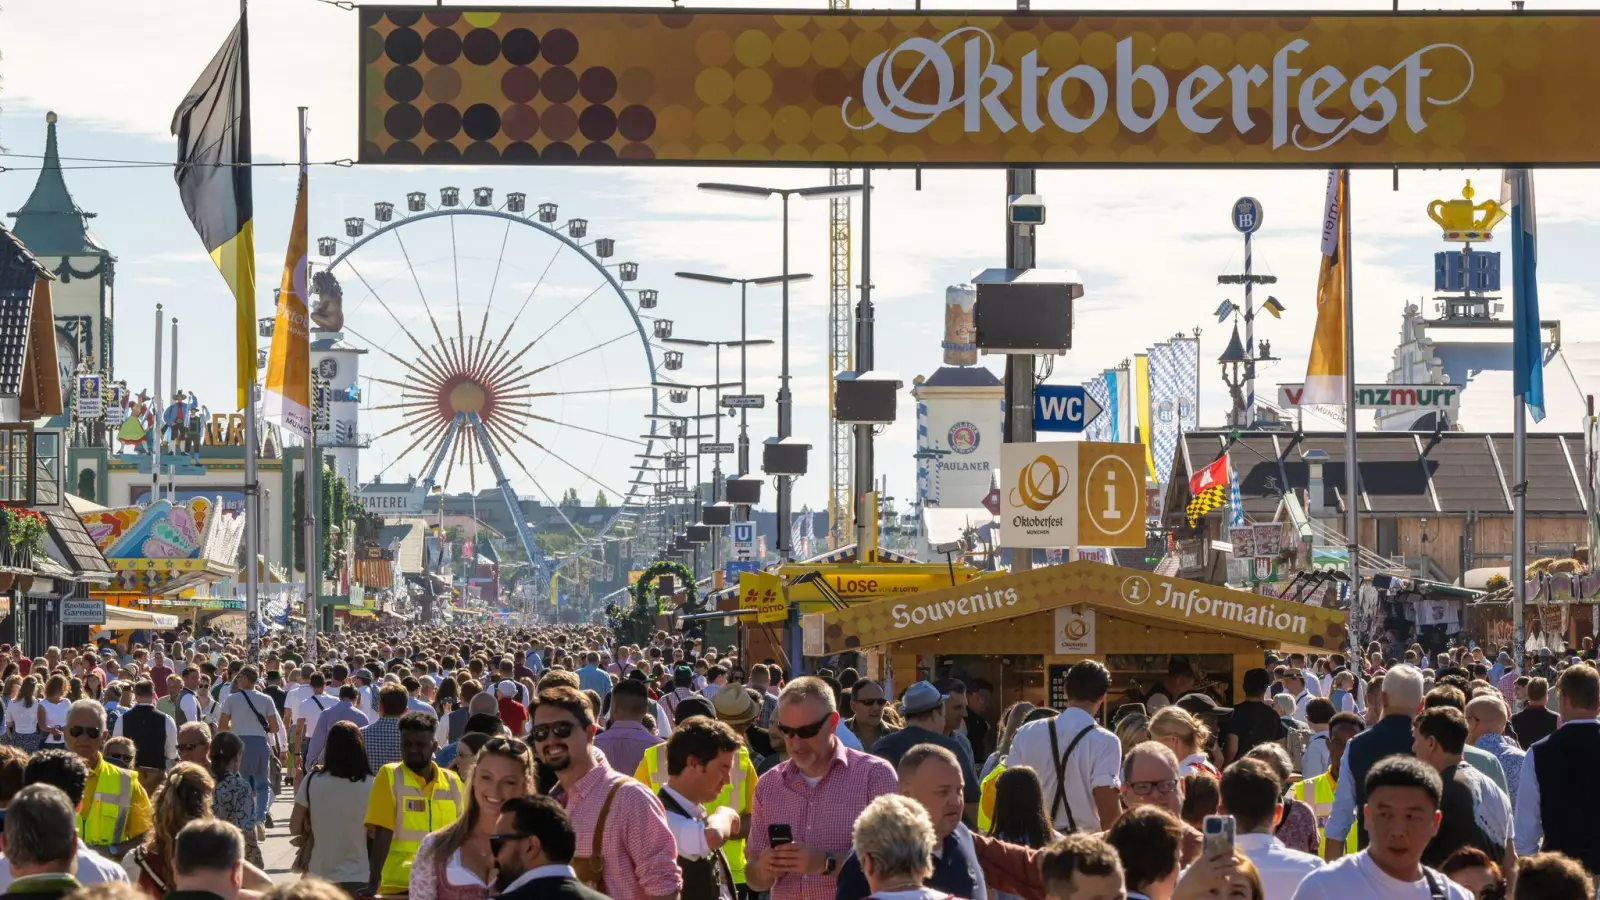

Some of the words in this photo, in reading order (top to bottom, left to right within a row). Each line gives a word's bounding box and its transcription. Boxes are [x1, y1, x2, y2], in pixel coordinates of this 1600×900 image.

[841, 25, 1475, 152] Oktoberfest
[1239, 213, 1253, 228] HB
[1284, 388, 1456, 406] vnzmurr
[1040, 397, 1083, 421] WC
[938, 461, 990, 471] PAULANER
[1012, 515, 1063, 528] Oktoberfest
[737, 526, 749, 541] U
[836, 576, 878, 593] Lose
[64, 608, 102, 617] Garnelen
[759, 603, 785, 613] LOTTO
[892, 586, 1018, 629] Souvenirs
[1155, 582, 1307, 634] Information
